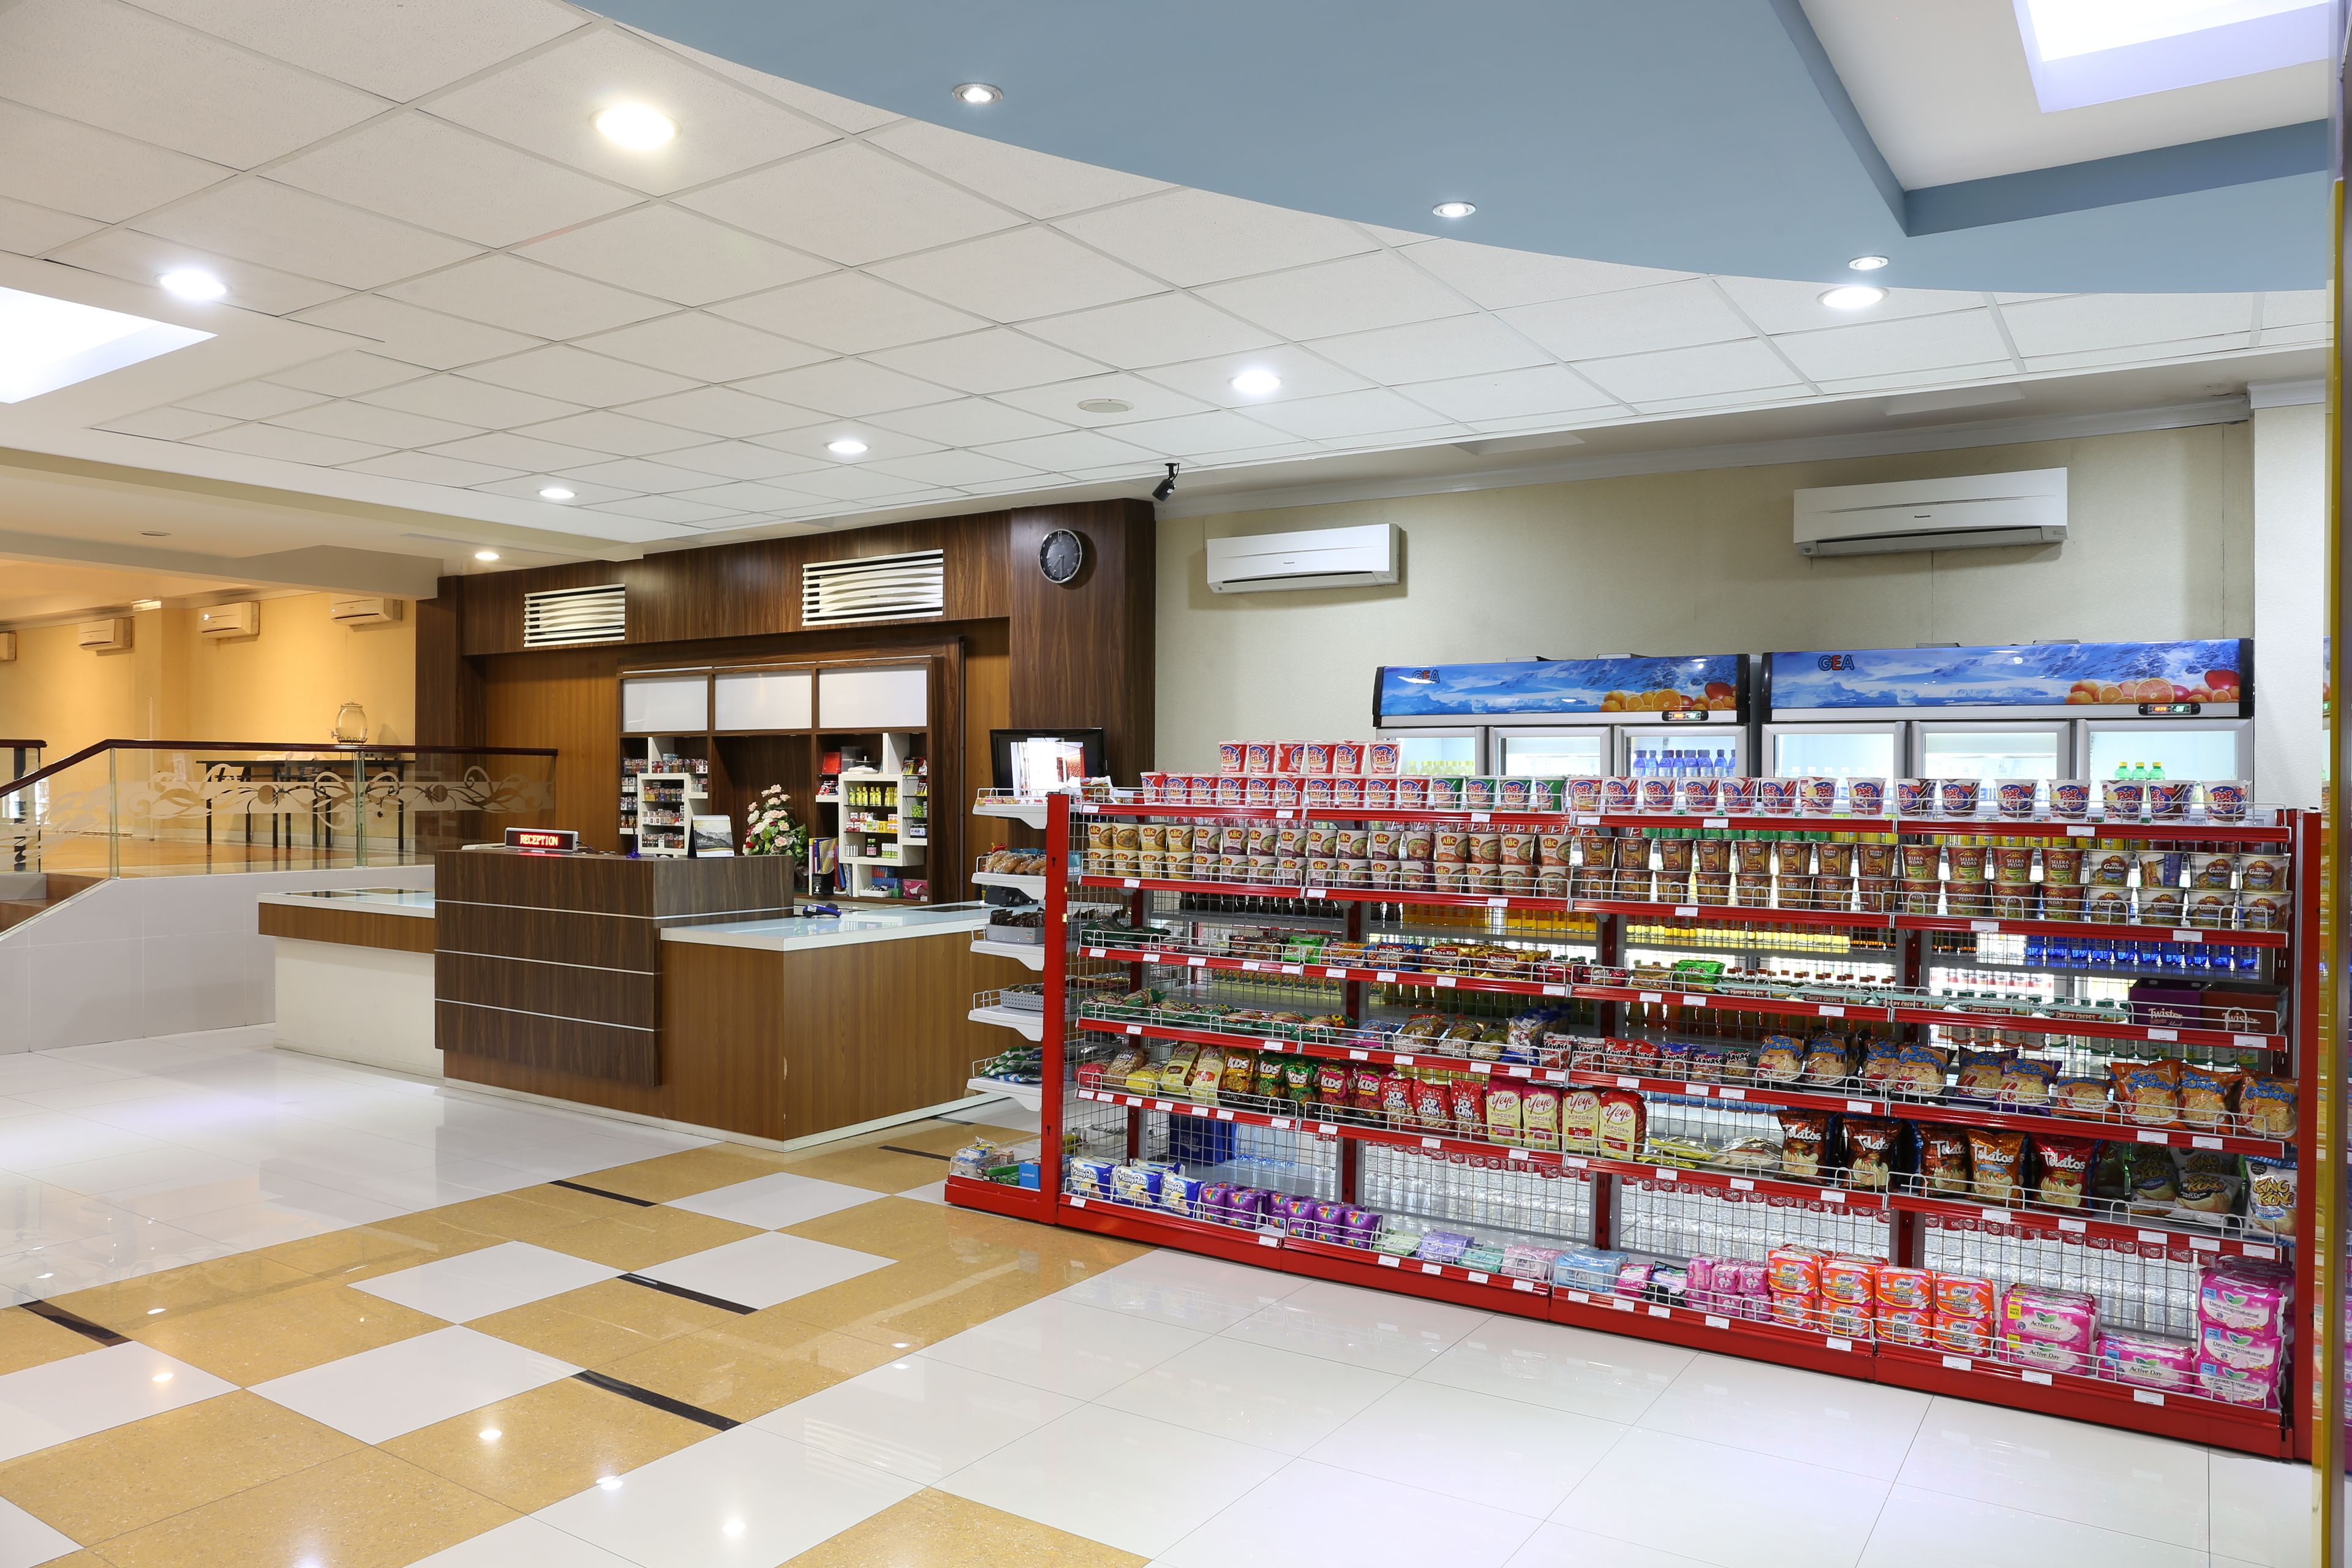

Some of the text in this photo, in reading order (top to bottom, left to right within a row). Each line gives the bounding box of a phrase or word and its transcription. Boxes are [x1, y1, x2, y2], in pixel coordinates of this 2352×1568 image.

[1818, 654, 1855, 671] GEA
[520, 834, 558, 846] RECEPTION
[2148, 1008, 2182, 1019] Twister
[1227, 1058, 1250, 1068] KDS
[1260, 1063, 1281, 1074] KDS
[1288, 1072, 1307, 1084] KDS
[1321, 1075, 1343, 1088] KDS
[1359, 1079, 1379, 1091] KDS
[1388, 1091, 1403, 1100] POP
[1386, 1098, 1406, 1108] CORN
[1422, 1098, 1437, 1107] POP
[1458, 1098, 1471, 1107] POP
[1492, 1093, 1515, 1112] Yeye
[1528, 1096, 1551, 1114] Yeye
[1570, 1095, 1594, 1114] Yeye
[1420, 1105, 1441, 1115] CORN
[1454, 1106, 1473, 1117] CORN
[1606, 1106, 1632, 1123] Yeye
[1604, 1124, 1629, 1133] POPCORN
[1072, 1167, 1097, 1180] MamyPoko
[1117, 1172, 1147, 1186] MamyPoko
[2253, 1178, 2290, 1194] KING
[2258, 1191, 2295, 1207] KONG
[2030, 1321, 2048, 1329] Active
